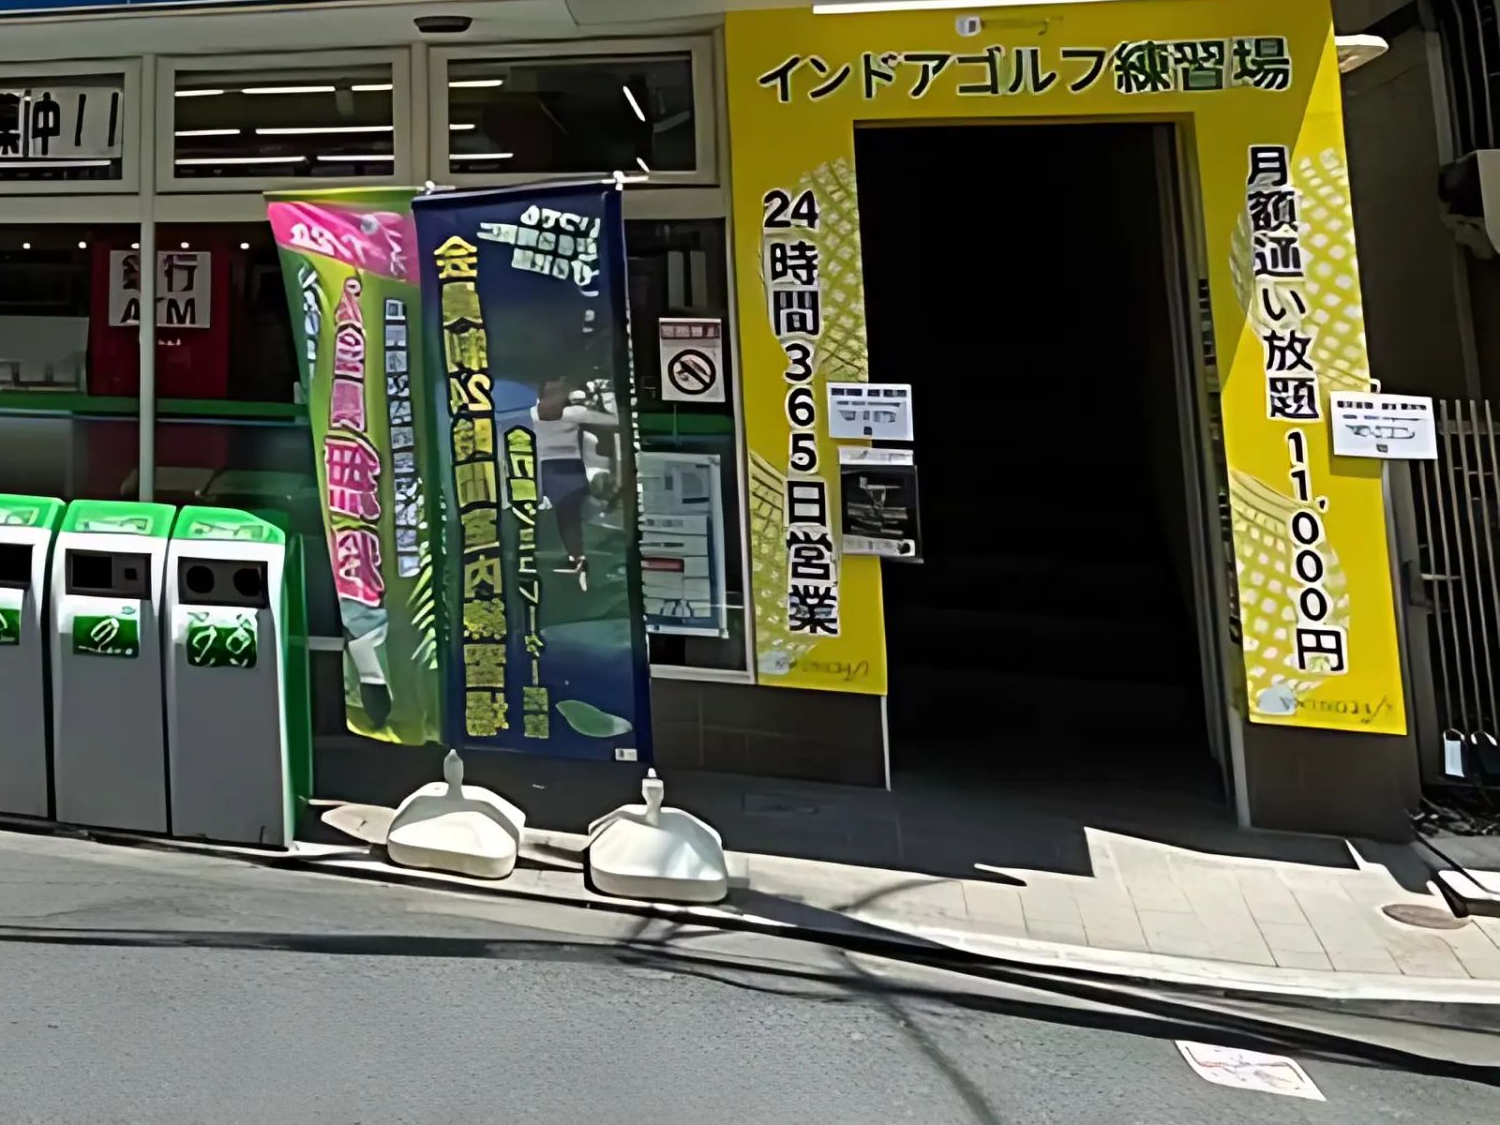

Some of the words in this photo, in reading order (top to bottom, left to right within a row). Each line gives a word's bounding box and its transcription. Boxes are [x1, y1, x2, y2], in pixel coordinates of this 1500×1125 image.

[759, 37, 1293, 104] インドアゴルフ練習場
[763, 189, 839, 635] 24時間365日営業
